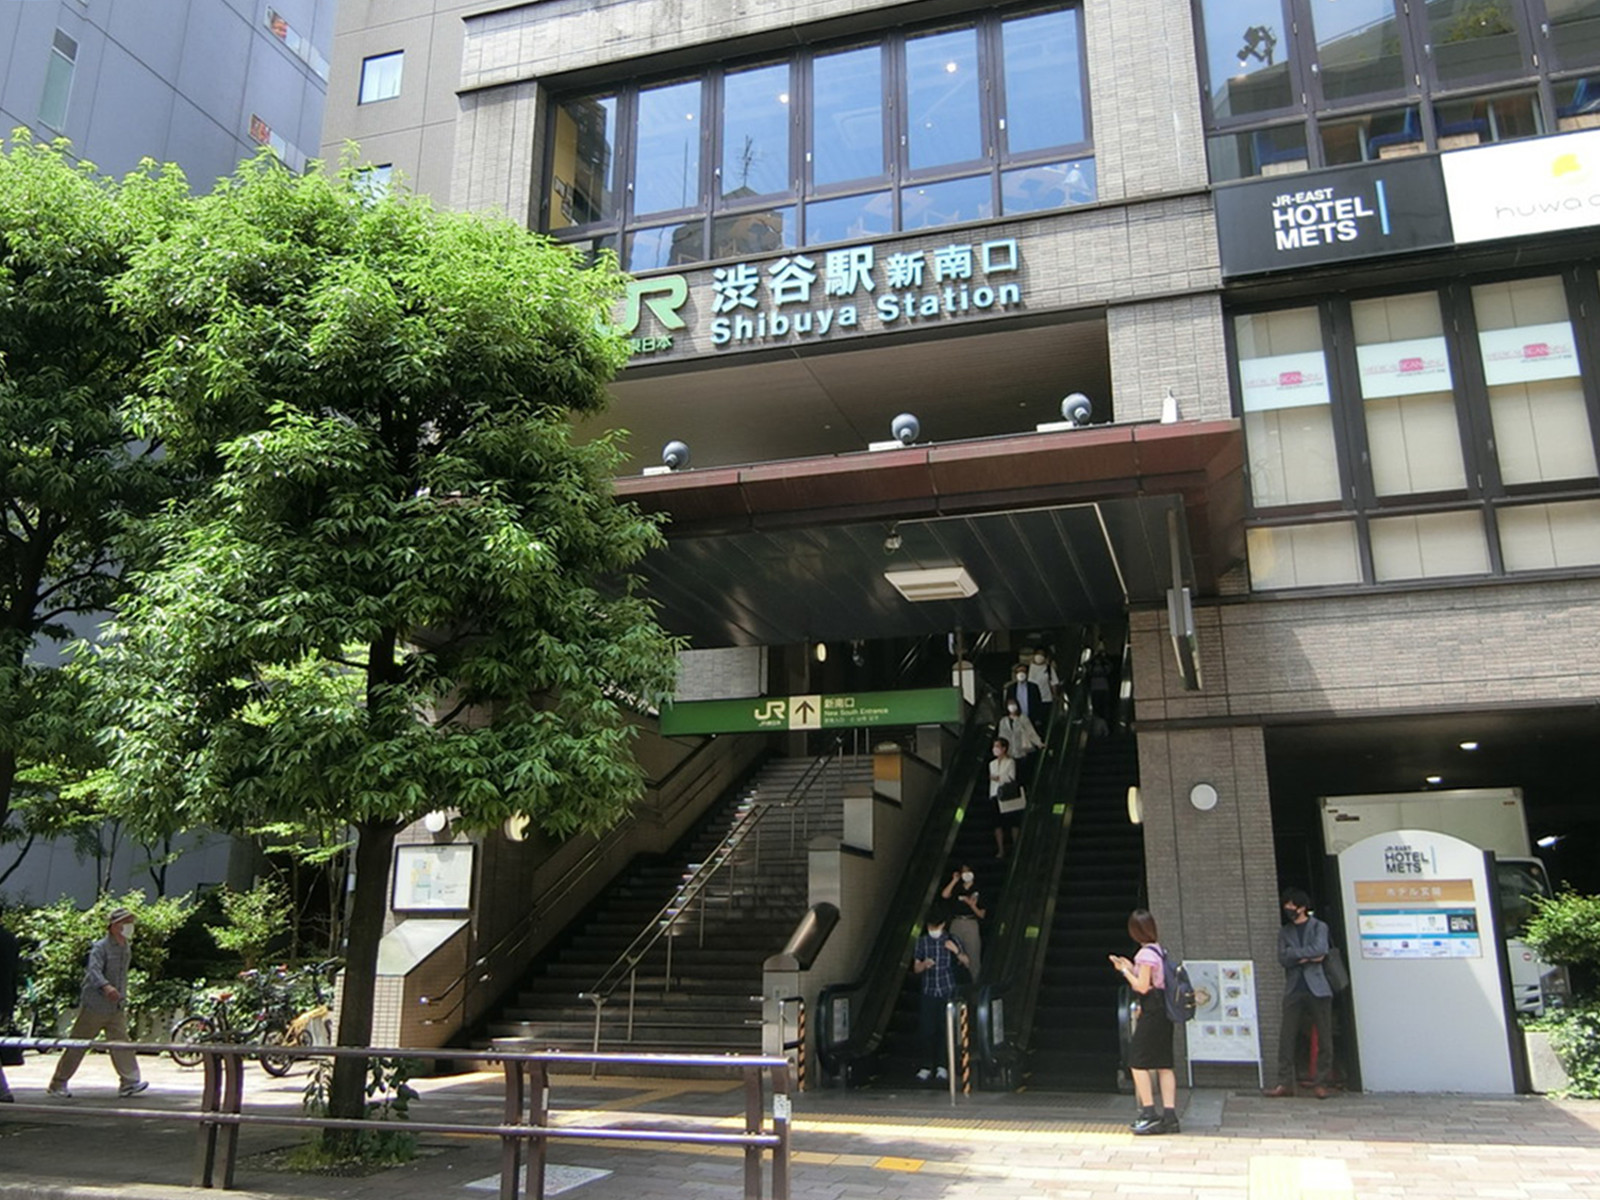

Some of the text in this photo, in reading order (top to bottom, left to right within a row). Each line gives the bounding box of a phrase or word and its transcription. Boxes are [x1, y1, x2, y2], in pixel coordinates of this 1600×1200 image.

[1271, 187, 1334, 208] JR-EAST
[1272, 196, 1374, 230] HOTEL
[1275, 220, 1359, 251] METS
[711, 239, 1018, 313] 渋谷駅 新南口
[710, 282, 1021, 346] Shibuya Station
[754, 700, 786, 721] JR
[1384, 851, 1430, 865] HOTEL
[1386, 863, 1422, 874] METS
